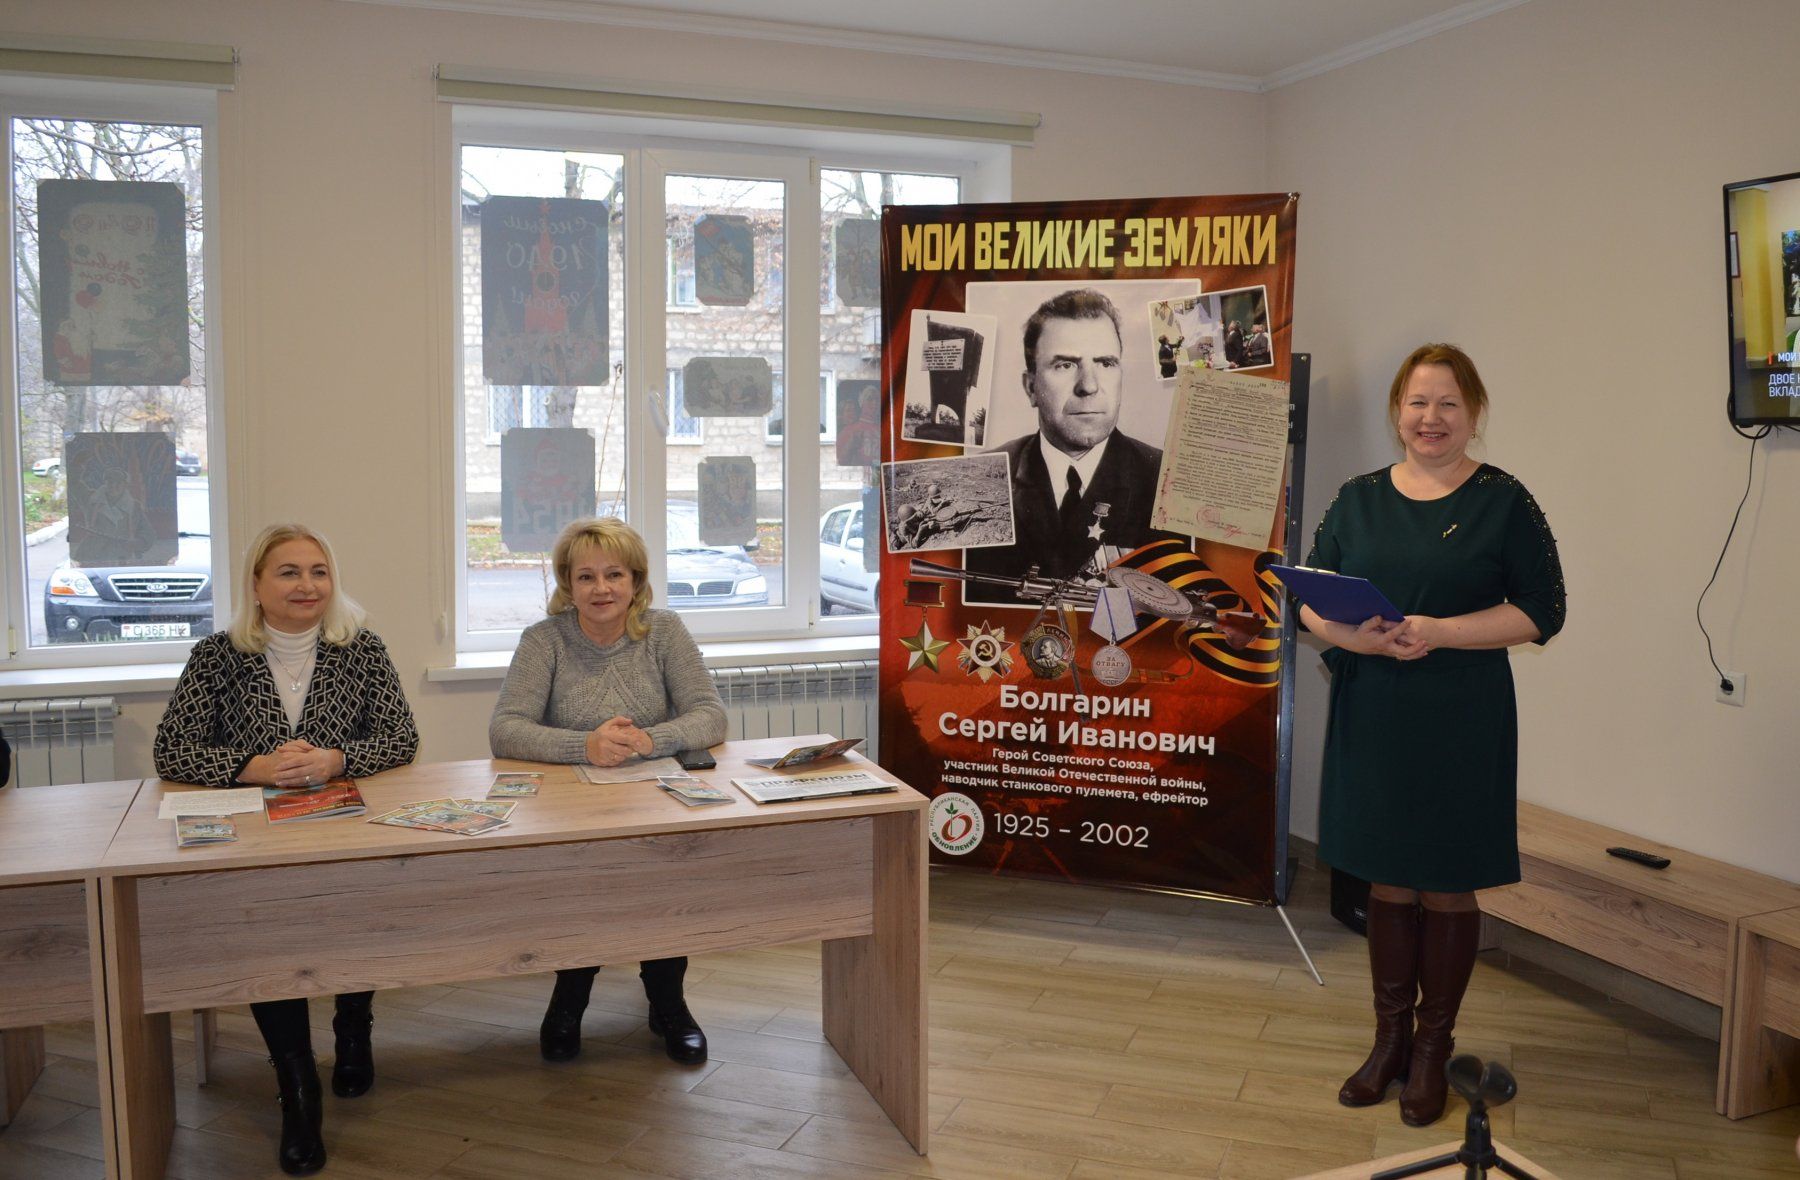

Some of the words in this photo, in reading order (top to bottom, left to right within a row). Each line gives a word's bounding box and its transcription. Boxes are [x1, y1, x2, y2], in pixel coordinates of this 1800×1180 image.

[902, 223, 965, 270] МОИ
[975, 219, 1114, 270] ВЕЛИКИЕ
[1124, 215, 1276, 267] ЗЕМЛЯКИ
[1769, 373, 1796, 386] ДВОЕ
[1001, 685, 1149, 718] Болгарин
[939, 712, 1046, 743] Сергей
[1059, 721, 1215, 755] Иванович
[944, 760, 998, 773] участник
[1003, 764, 1055, 777] Великой
[1059, 769, 1156, 786] Отечественной
[1160, 778, 1206, 792] войны,
[993, 748, 1028, 761] Герой
[1033, 752, 1105, 766] Советского
[1109, 757, 1154, 771] Союза,
[942, 774, 998, 788] наводчик
[1002, 780, 1072, 794] станкового
[1076, 786, 1139, 802] пулемета,
[1143, 792, 1208, 807] ефрейтор
[932, 831, 978, 851] ОБНОВЛЕНИЕ
[995, 813, 1049, 837] 1925
[1081, 822, 1149, 848] 2002
